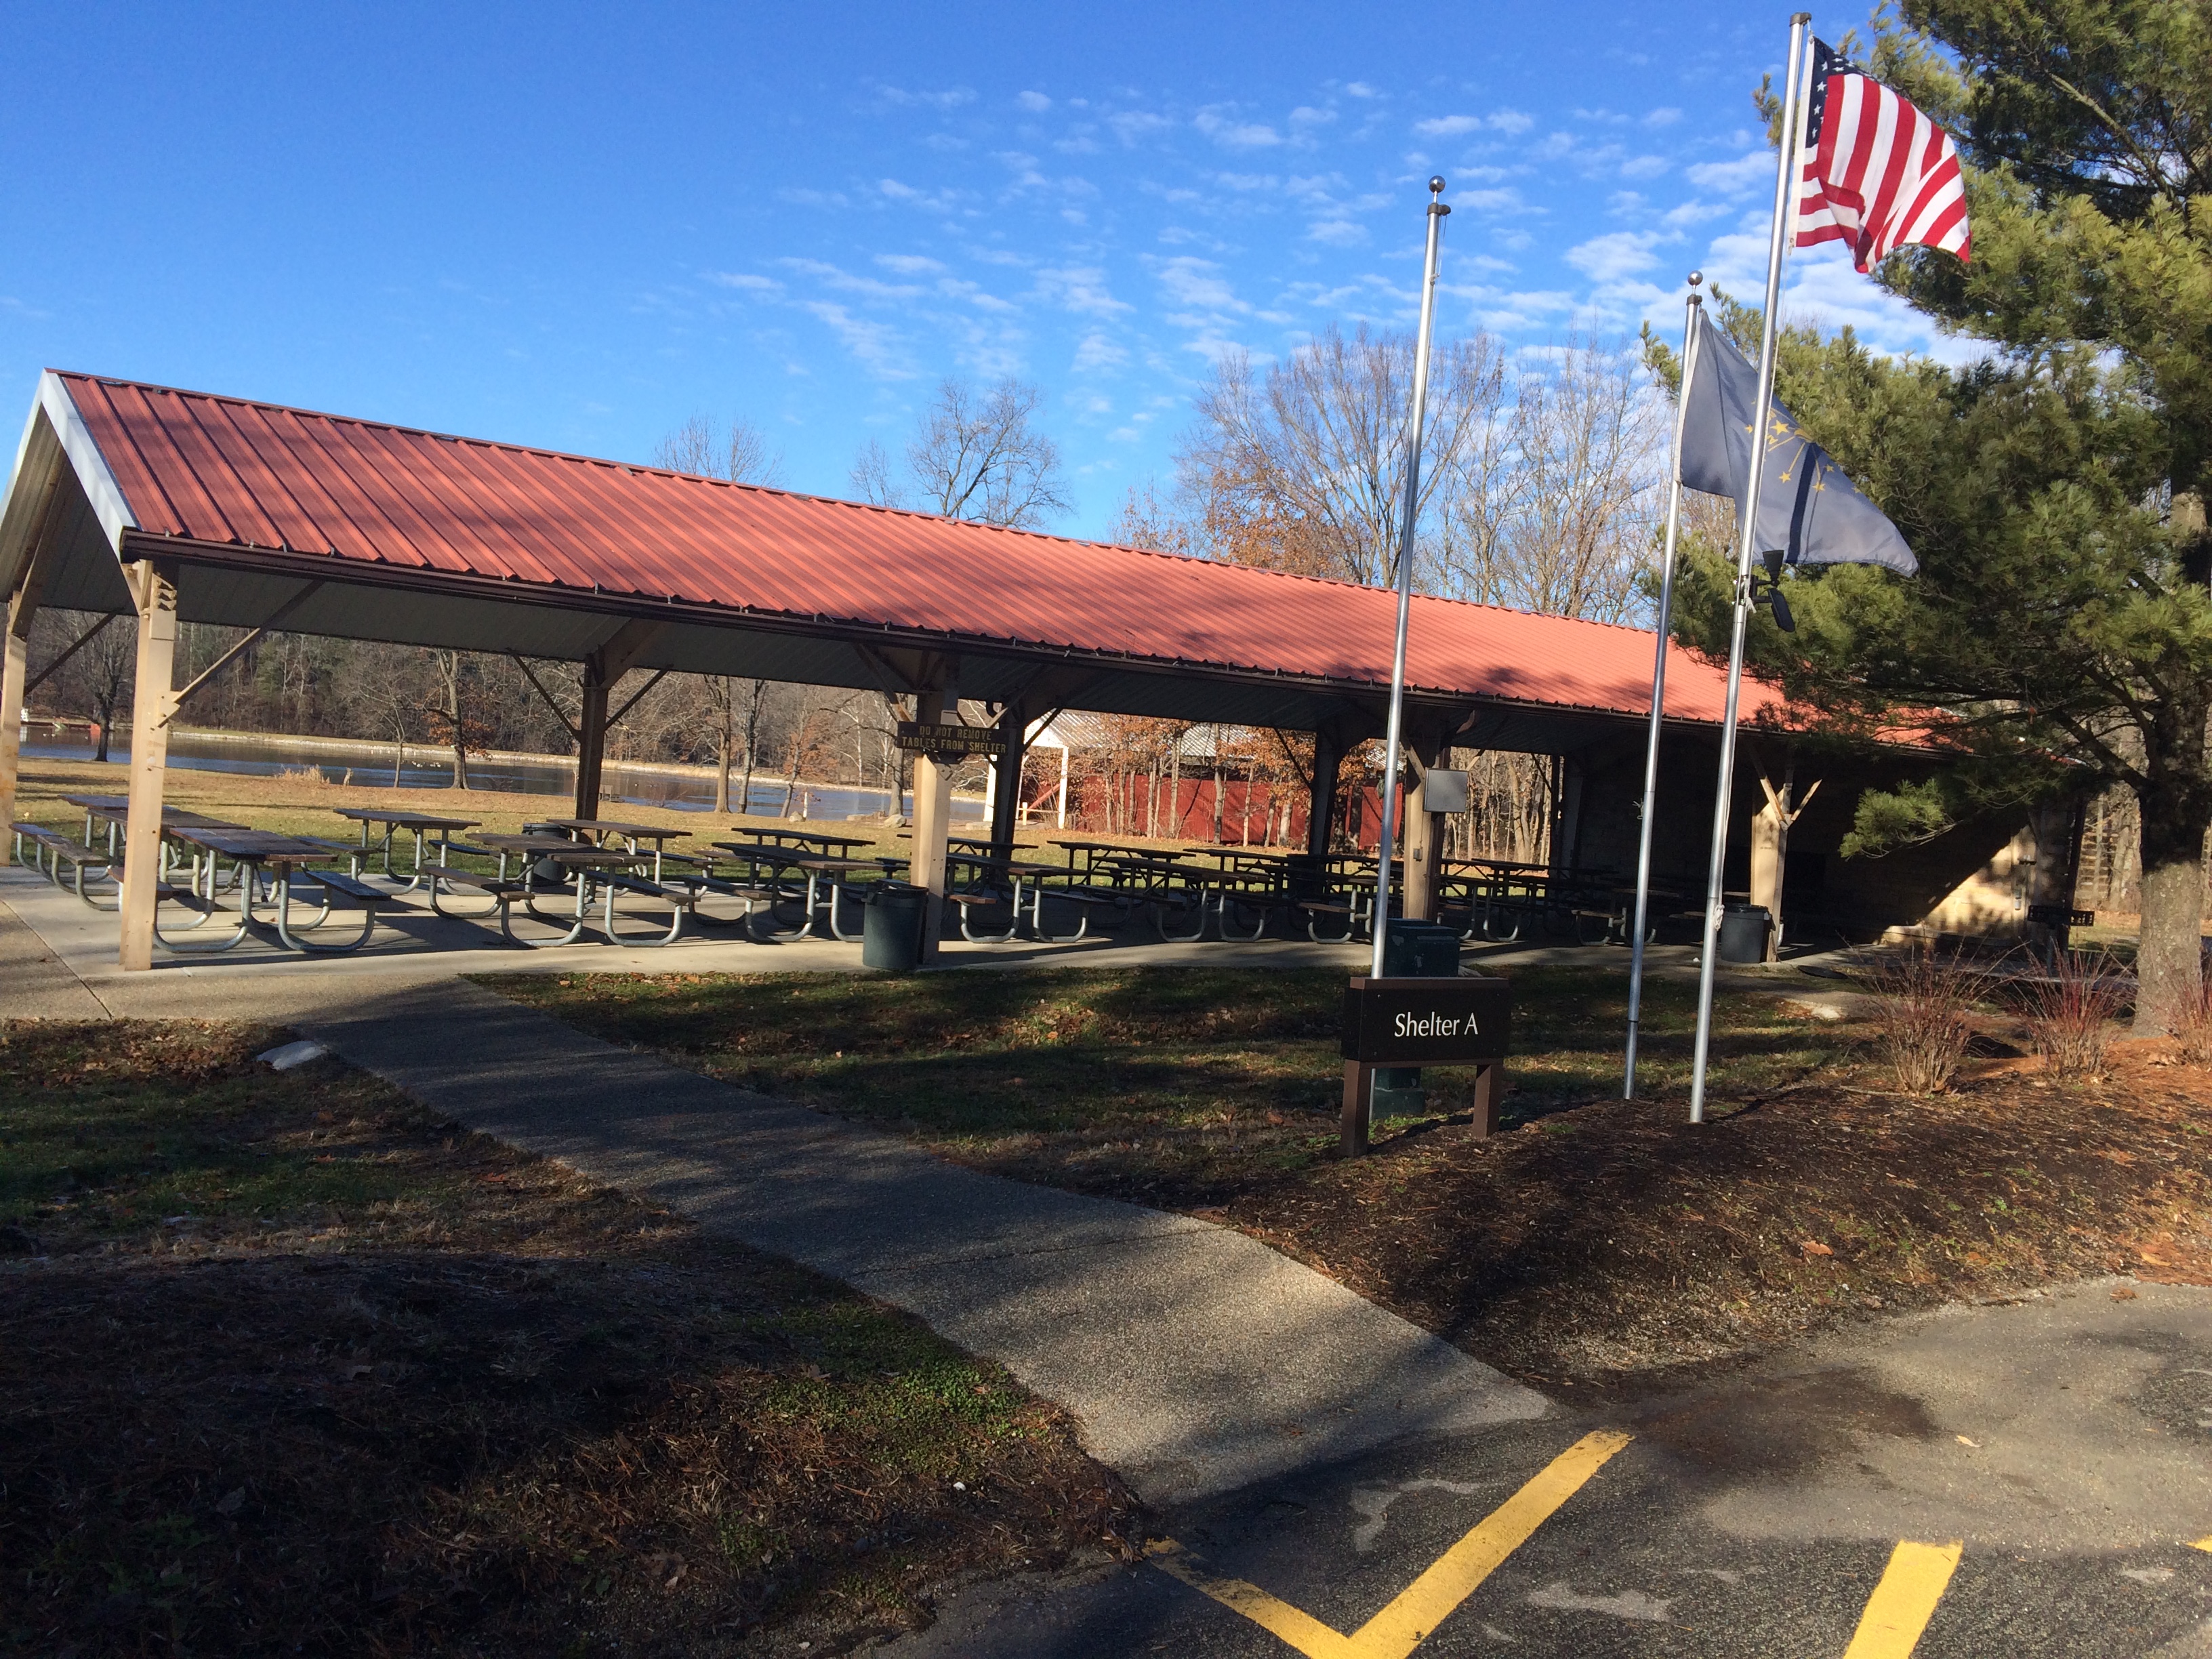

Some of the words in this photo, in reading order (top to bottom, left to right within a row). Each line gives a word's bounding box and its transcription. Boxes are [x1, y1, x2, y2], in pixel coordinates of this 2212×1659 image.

[919, 726, 931, 735] DO
[935, 727, 952, 737] NOT
[957, 729, 992, 740] REMOVE
[902, 737, 936, 748] TABLES
[941, 740, 964, 750] FROM
[968, 741, 1006, 753] SHELTER
[1394, 1011, 1460, 1037] Shelter
[1464, 1012, 1478, 1036] A
